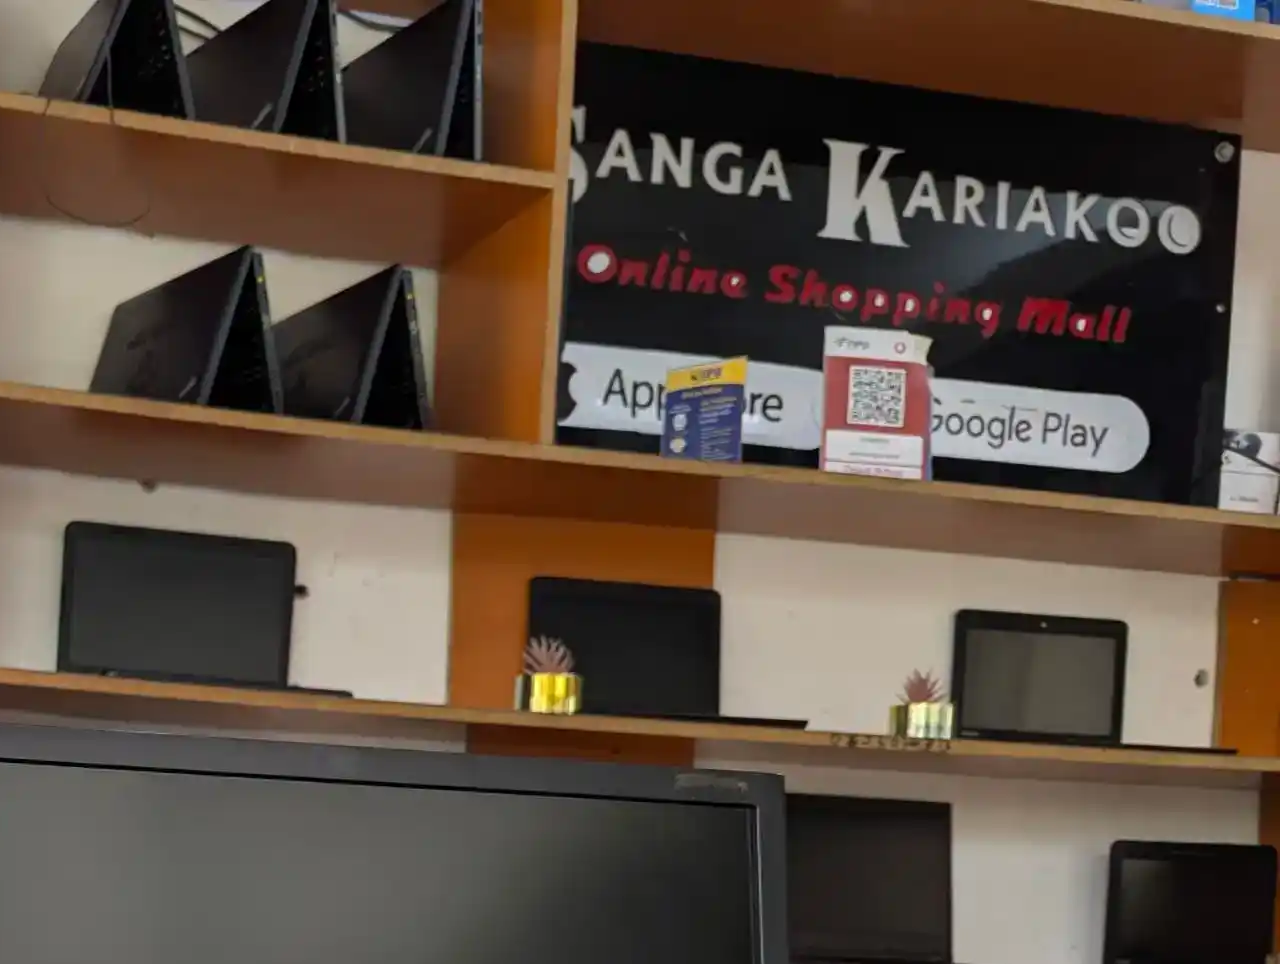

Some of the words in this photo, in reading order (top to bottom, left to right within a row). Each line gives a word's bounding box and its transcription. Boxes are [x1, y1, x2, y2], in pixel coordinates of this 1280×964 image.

[817, 138, 1201, 254] KARIAKOO
[577, 244, 747, 298] Online
[764, 264, 1002, 338] Shopping
[1017, 295, 1132, 343] Mall
[1042, 411, 1109, 457] Play
